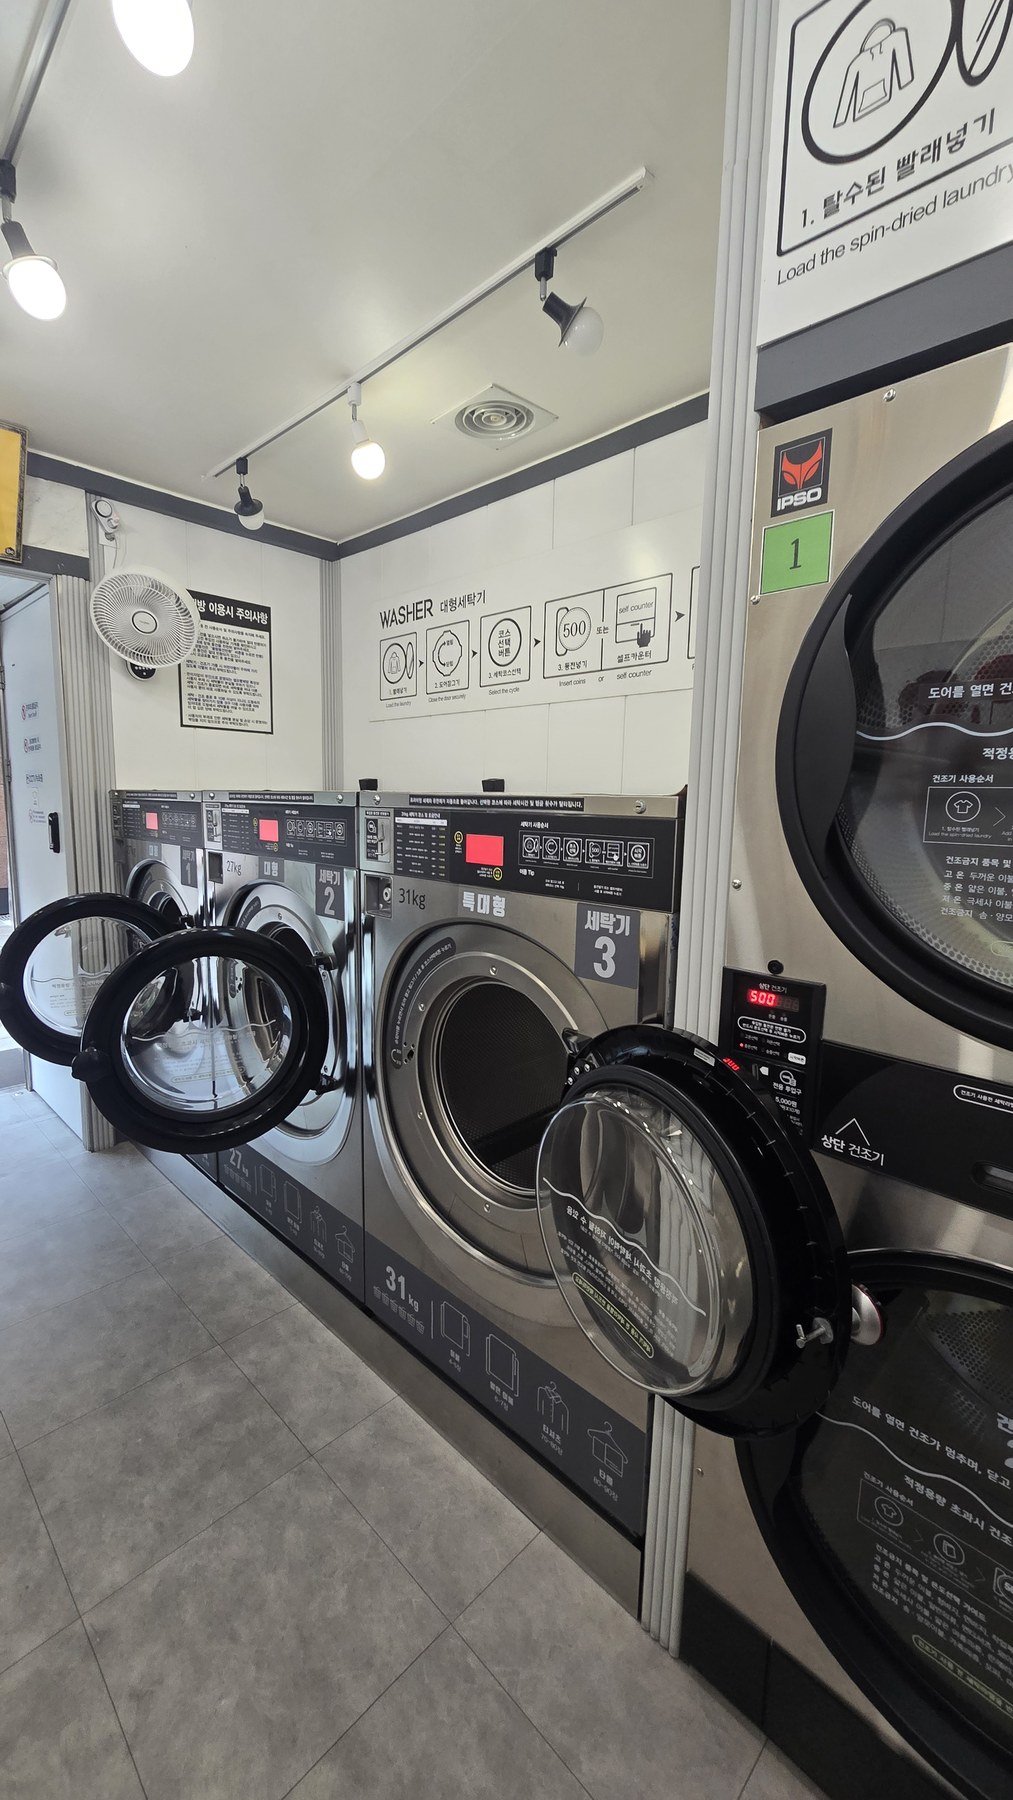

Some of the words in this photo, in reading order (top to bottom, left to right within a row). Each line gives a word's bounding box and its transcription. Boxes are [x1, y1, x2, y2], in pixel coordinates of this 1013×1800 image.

[801, 209, 815, 228] 1.
[823, 166, 886, 219] 탈수된
[896, 107, 995, 182] 빨래넣기
[777, 254, 816, 285] Load
[820, 243, 846, 266] the
[849, 195, 937, 252] spin-dried
[776, 486, 822, 512] IPSO
[789, 537, 802, 570] 1
[208, 601, 234, 618] 이용시
[236, 607, 269, 625] 주의사항
[379, 598, 434, 629] WASHER
[440, 589, 486, 613] 대형세탁기
[618, 605, 629, 614] self
[630, 601, 654, 612] counter
[498, 628, 511, 638] 코스
[563, 620, 586, 638] 500
[596, 626, 609, 635] 또는
[497, 638, 511, 649] 선택
[498, 648, 511, 657] 버튼
[616, 650, 652, 663] 셀프카운터
[559, 679, 573, 687] Insert
[616, 672, 627, 680] self
[628, 670, 652, 679] counter
[488, 688, 501, 696] Select
[508, 687, 520, 695] cycle
[928, 685, 965, 699] 도어를
[970, 683, 994, 697] 열면
[1000, 681, 1013, 696] 건
[932, 774, 956, 783] 건조기
[959, 774, 994, 783] 사용순서
[226, 860, 242, 876] 27kg
[945, 855, 979, 866] 건조금지
[982, 858, 1000, 867] 품목
[1002, 859, 1011, 869] 및
[186, 862, 191, 885] 1
[319, 869, 341, 886] 세탁기
[969, 871, 996, 882] 두꺼운
[324, 886, 335, 916] 2
[398, 887, 426, 910] 31kg
[462, 890, 506, 918] 특대형
[967, 896, 993, 907] 극세사
[940, 906, 973, 918] 건조금지
[584, 909, 631, 937] 세탁기
[593, 935, 616, 979] 3
[749, 989, 776, 1007] 500
[821, 1134, 846, 1153] 상단
[848, 1143, 885, 1167] 건조기
[852, 1395, 882, 1419] 도어를
[885, 1413, 905, 1432] 열면
[908, 1426, 941, 1451] 건조가
[945, 1445, 982, 1475] 멈추며,
[986, 1468, 1012, 1490] 닫고
[903, 1474, 947, 1507] 적정용량
[950, 1503, 985, 1531] 초과시
